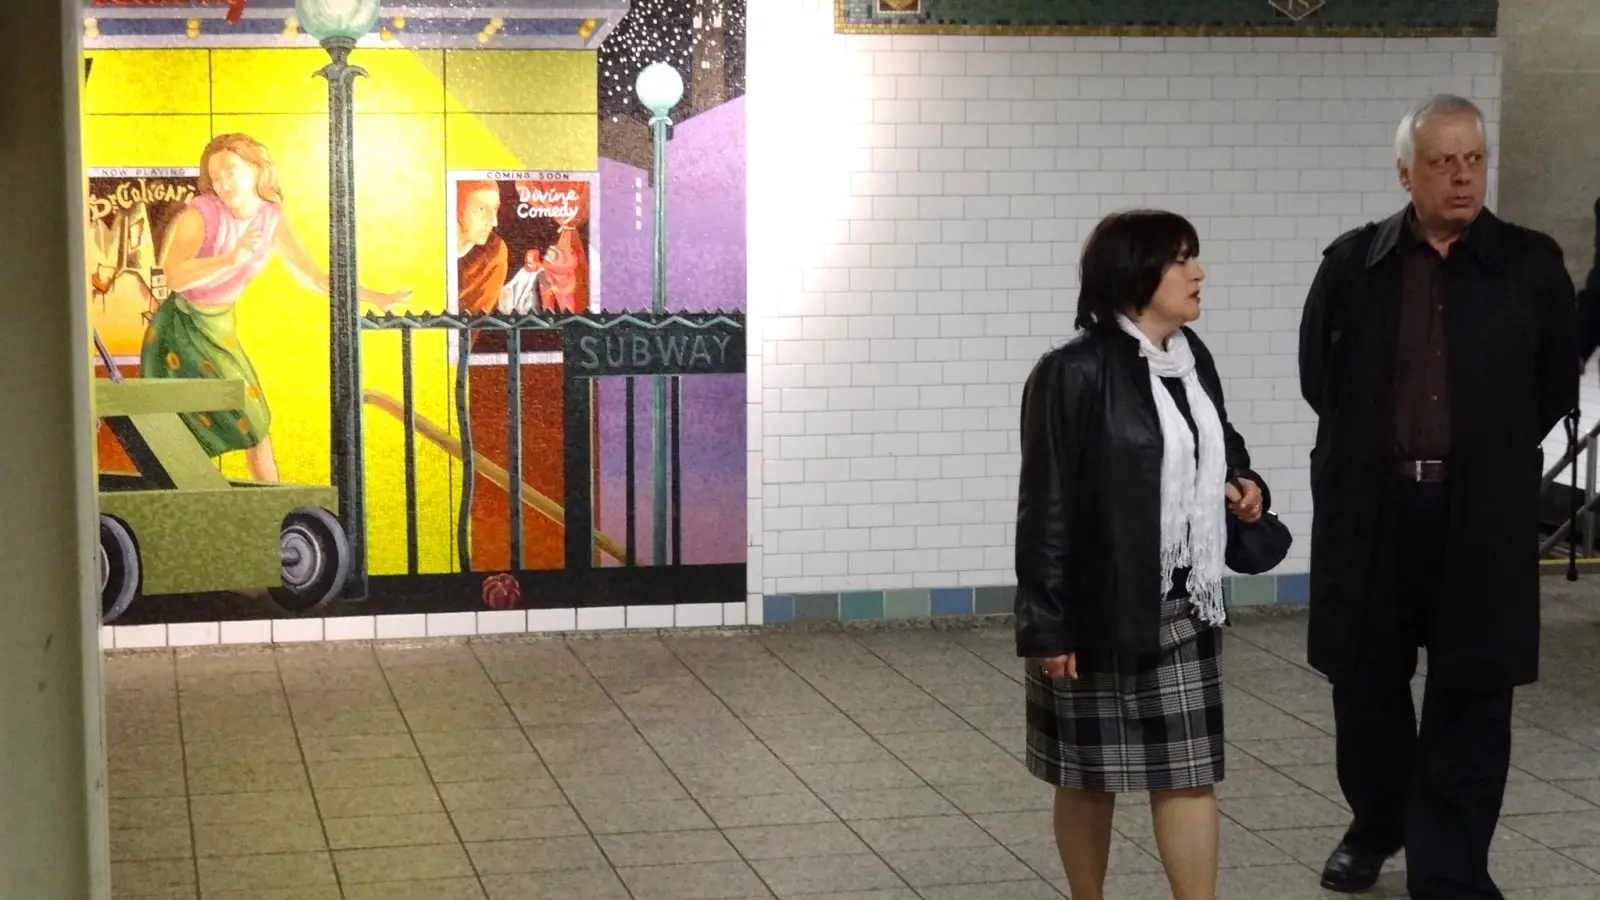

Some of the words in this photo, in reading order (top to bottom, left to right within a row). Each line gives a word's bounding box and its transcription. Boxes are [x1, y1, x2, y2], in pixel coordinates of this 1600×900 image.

[486, 171, 531, 180] COMING
[538, 171, 570, 180] SOON
[519, 187, 579, 203] Divine
[517, 203, 579, 224] Comedy
[580, 335, 731, 369] SUBWAY
